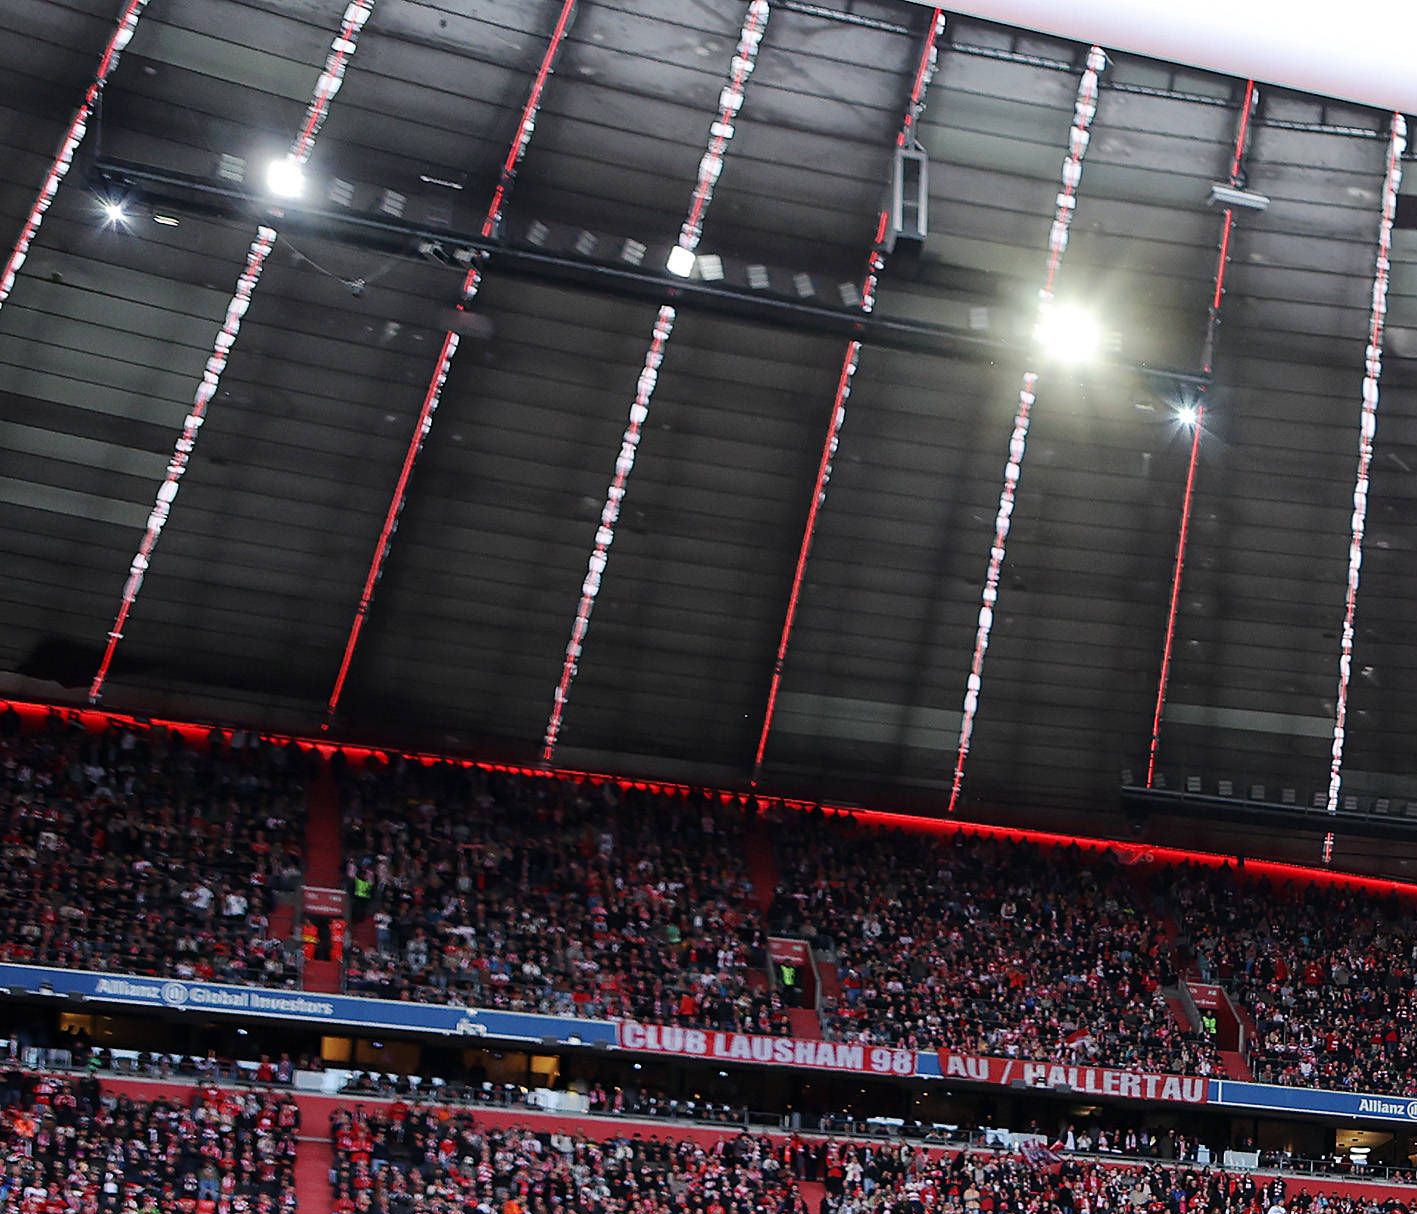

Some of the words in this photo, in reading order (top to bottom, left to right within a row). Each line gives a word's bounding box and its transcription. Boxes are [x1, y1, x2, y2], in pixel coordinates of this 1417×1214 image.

[96, 979, 160, 998] Allianz
[190, 989, 248, 1006] Global
[250, 994, 333, 1014] Investors
[622, 1022, 707, 1054] CLUB
[713, 1032, 864, 1070] LAUSHAM
[871, 1049, 912, 1074] 98
[948, 1055, 989, 1081] AU
[1023, 1062, 1205, 1101] HALLERTAU
[1359, 1099, 1405, 1114] Allianz
